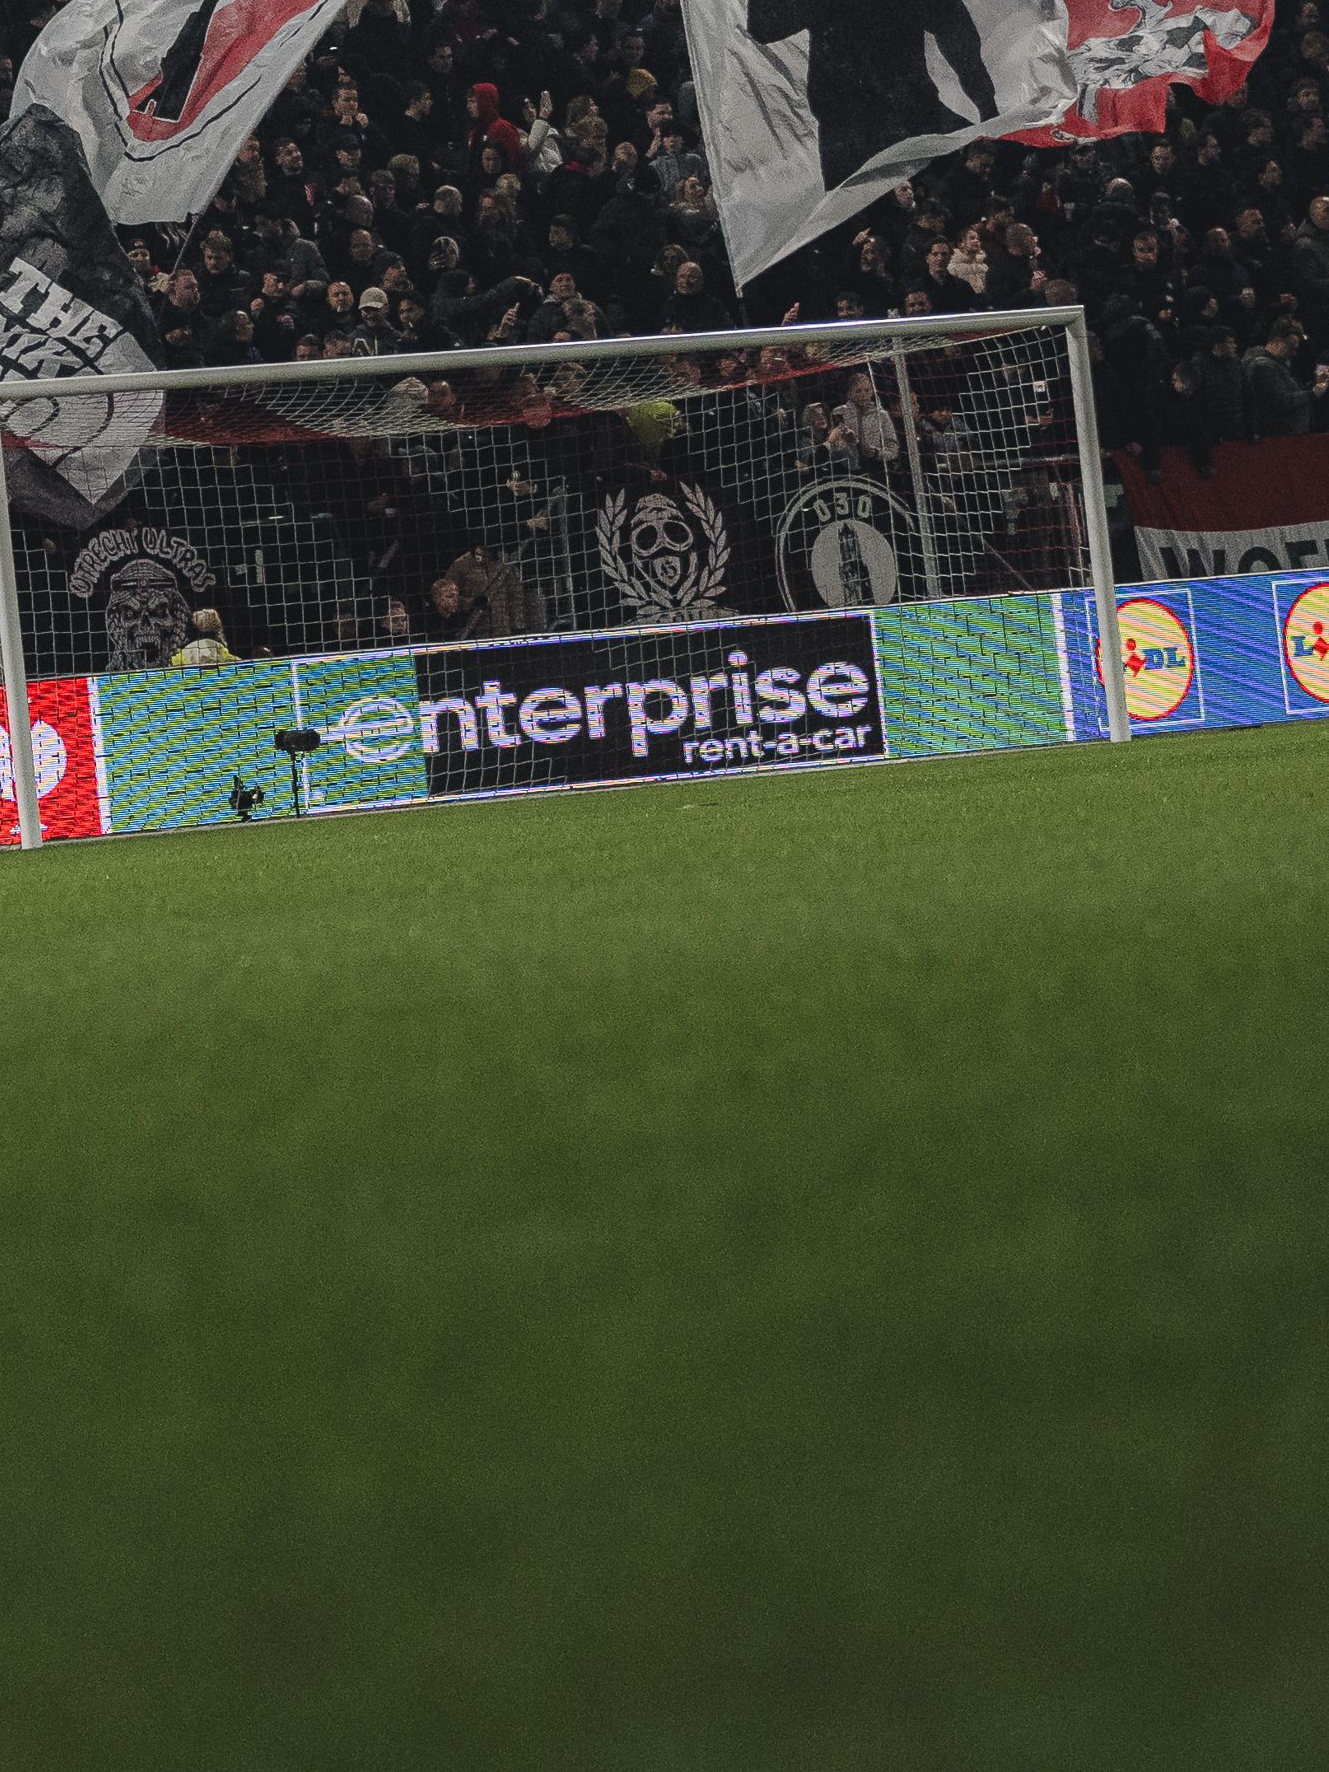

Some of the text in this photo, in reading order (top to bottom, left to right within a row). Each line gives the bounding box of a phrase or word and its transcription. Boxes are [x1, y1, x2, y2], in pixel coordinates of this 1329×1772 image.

[813, 491, 873, 524] 030
[318, 652, 870, 760] enterprise
[683, 724, 873, 765] rent-a-car
